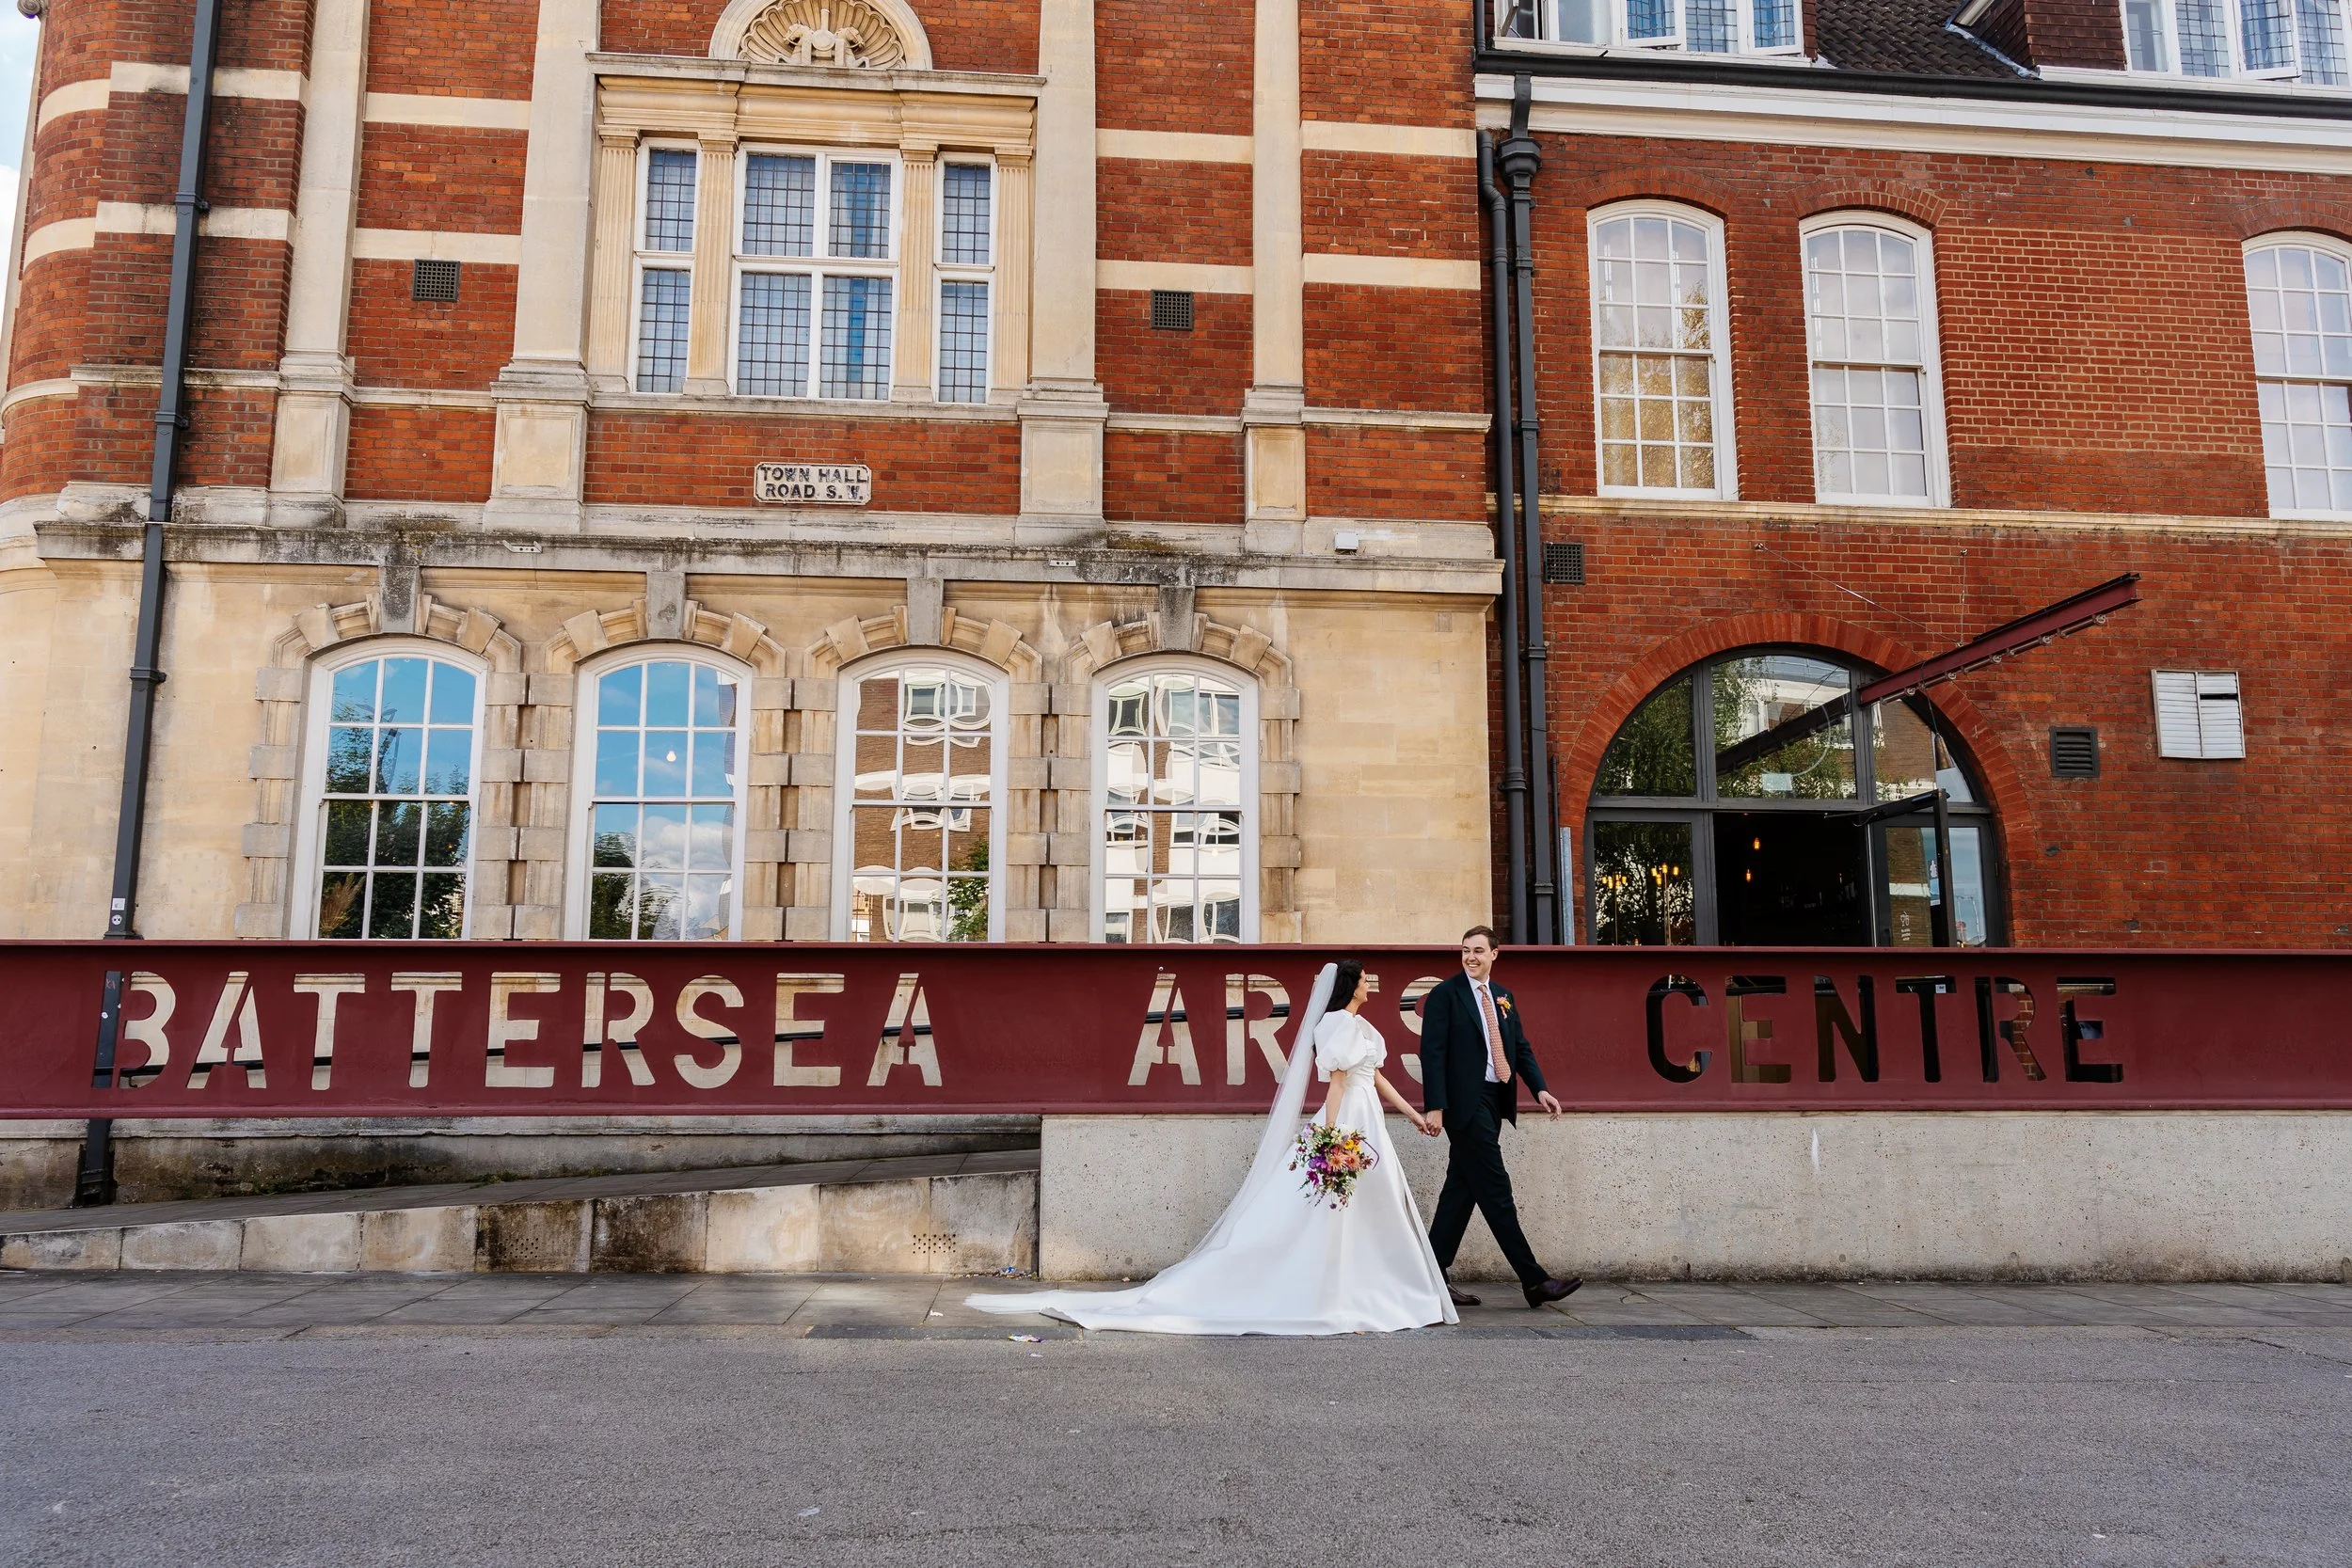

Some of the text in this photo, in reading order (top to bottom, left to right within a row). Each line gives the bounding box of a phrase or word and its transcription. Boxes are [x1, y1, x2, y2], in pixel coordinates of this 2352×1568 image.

[760, 467, 867, 483] TOWN HALL
[765, 483, 816, 499] ROAD
[91, 971, 2123, 1089] BATTERSEA AR CENTRE
